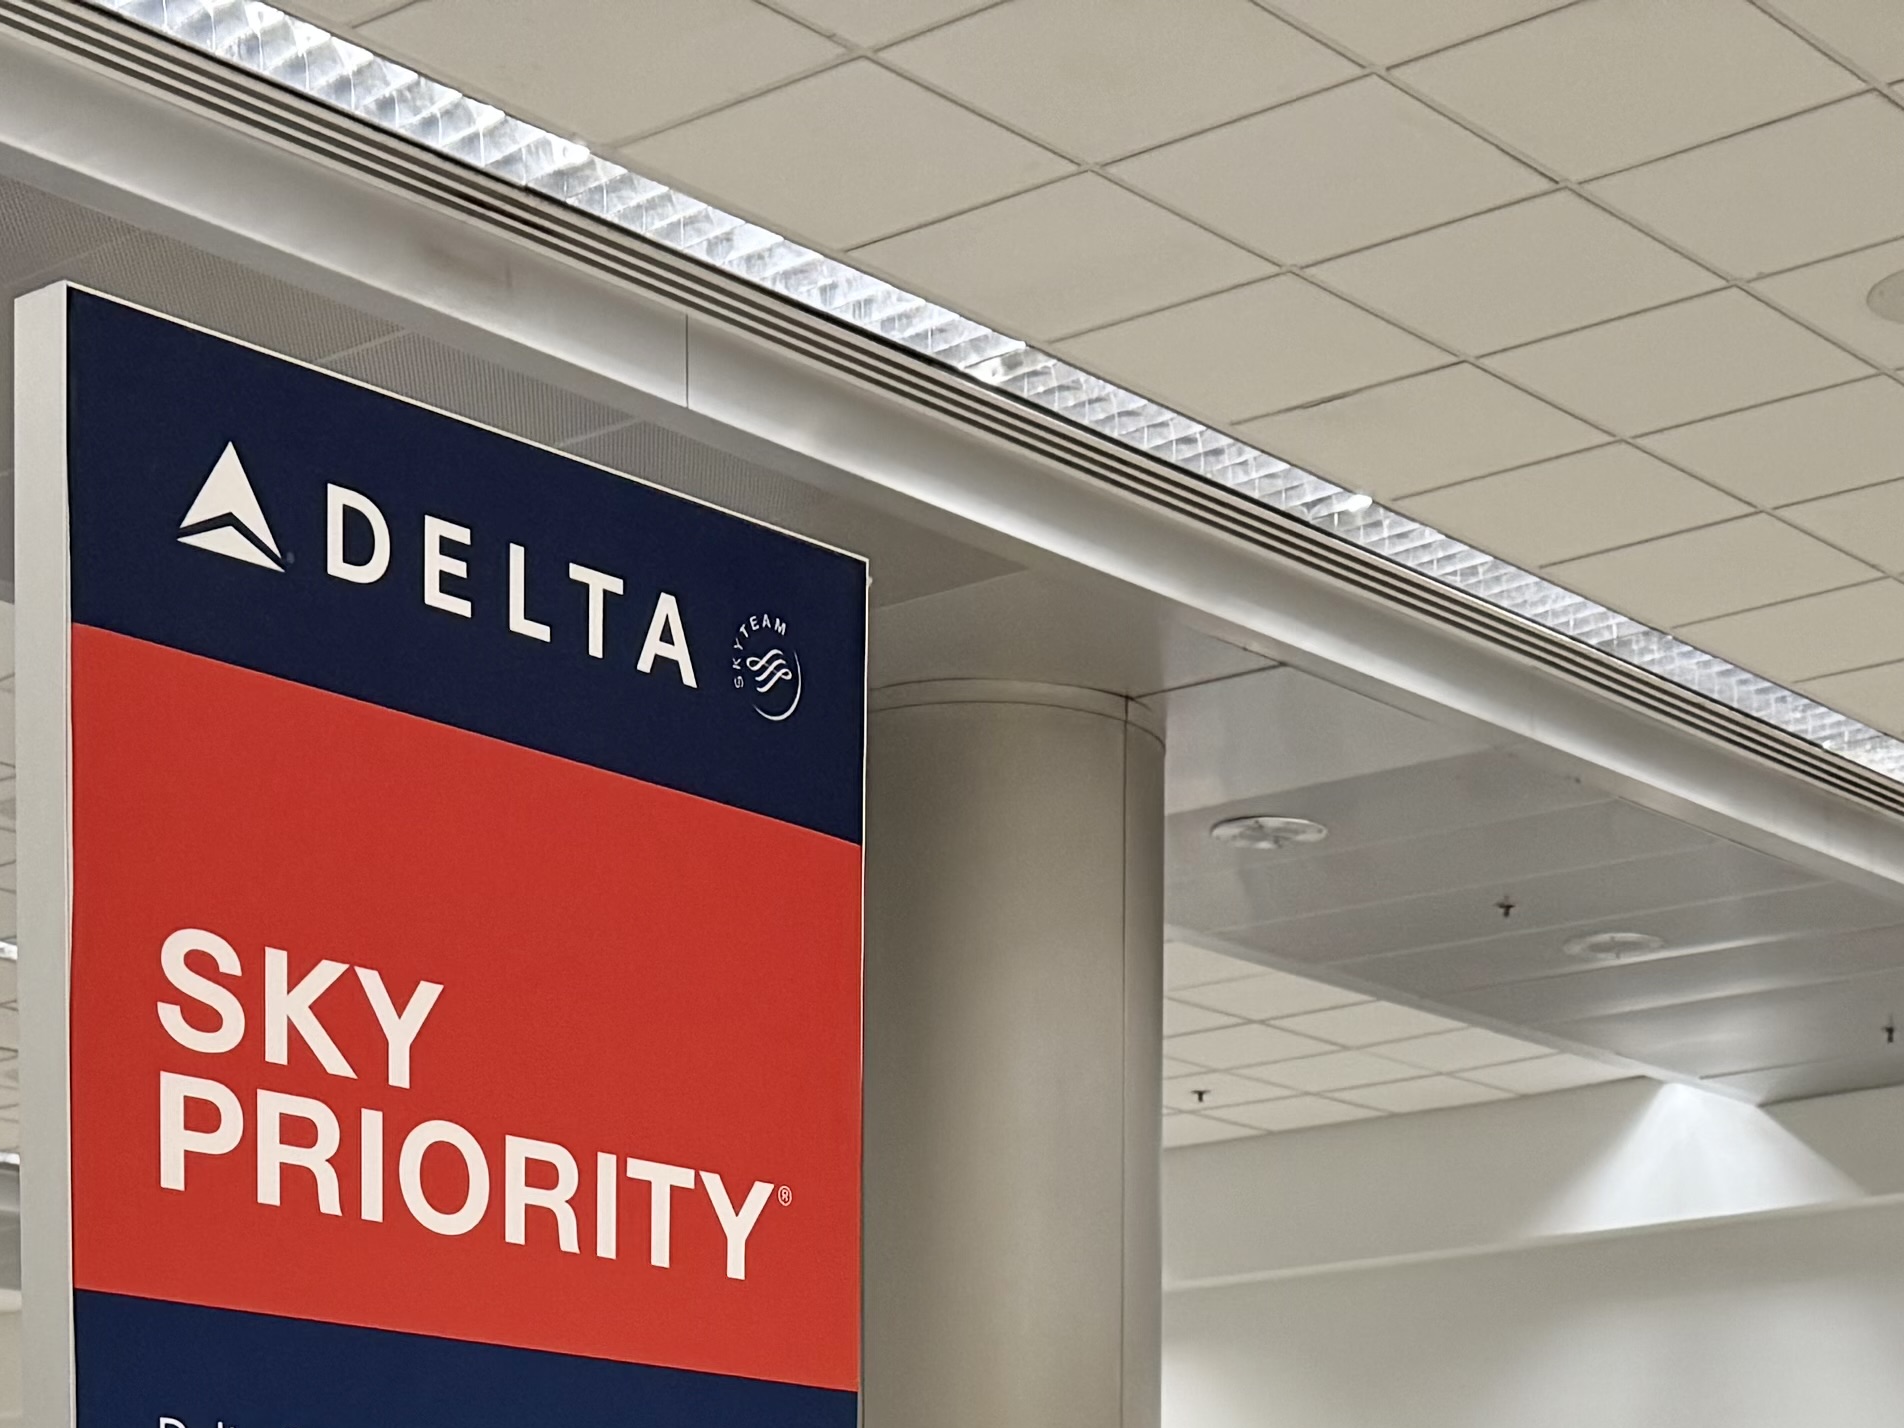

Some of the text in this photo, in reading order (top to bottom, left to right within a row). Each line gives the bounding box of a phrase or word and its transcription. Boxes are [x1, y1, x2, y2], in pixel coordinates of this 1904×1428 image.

[327, 483, 698, 689] DELTA
[733, 613, 789, 690] SKYTEAM
[158, 929, 443, 1090] SKY
